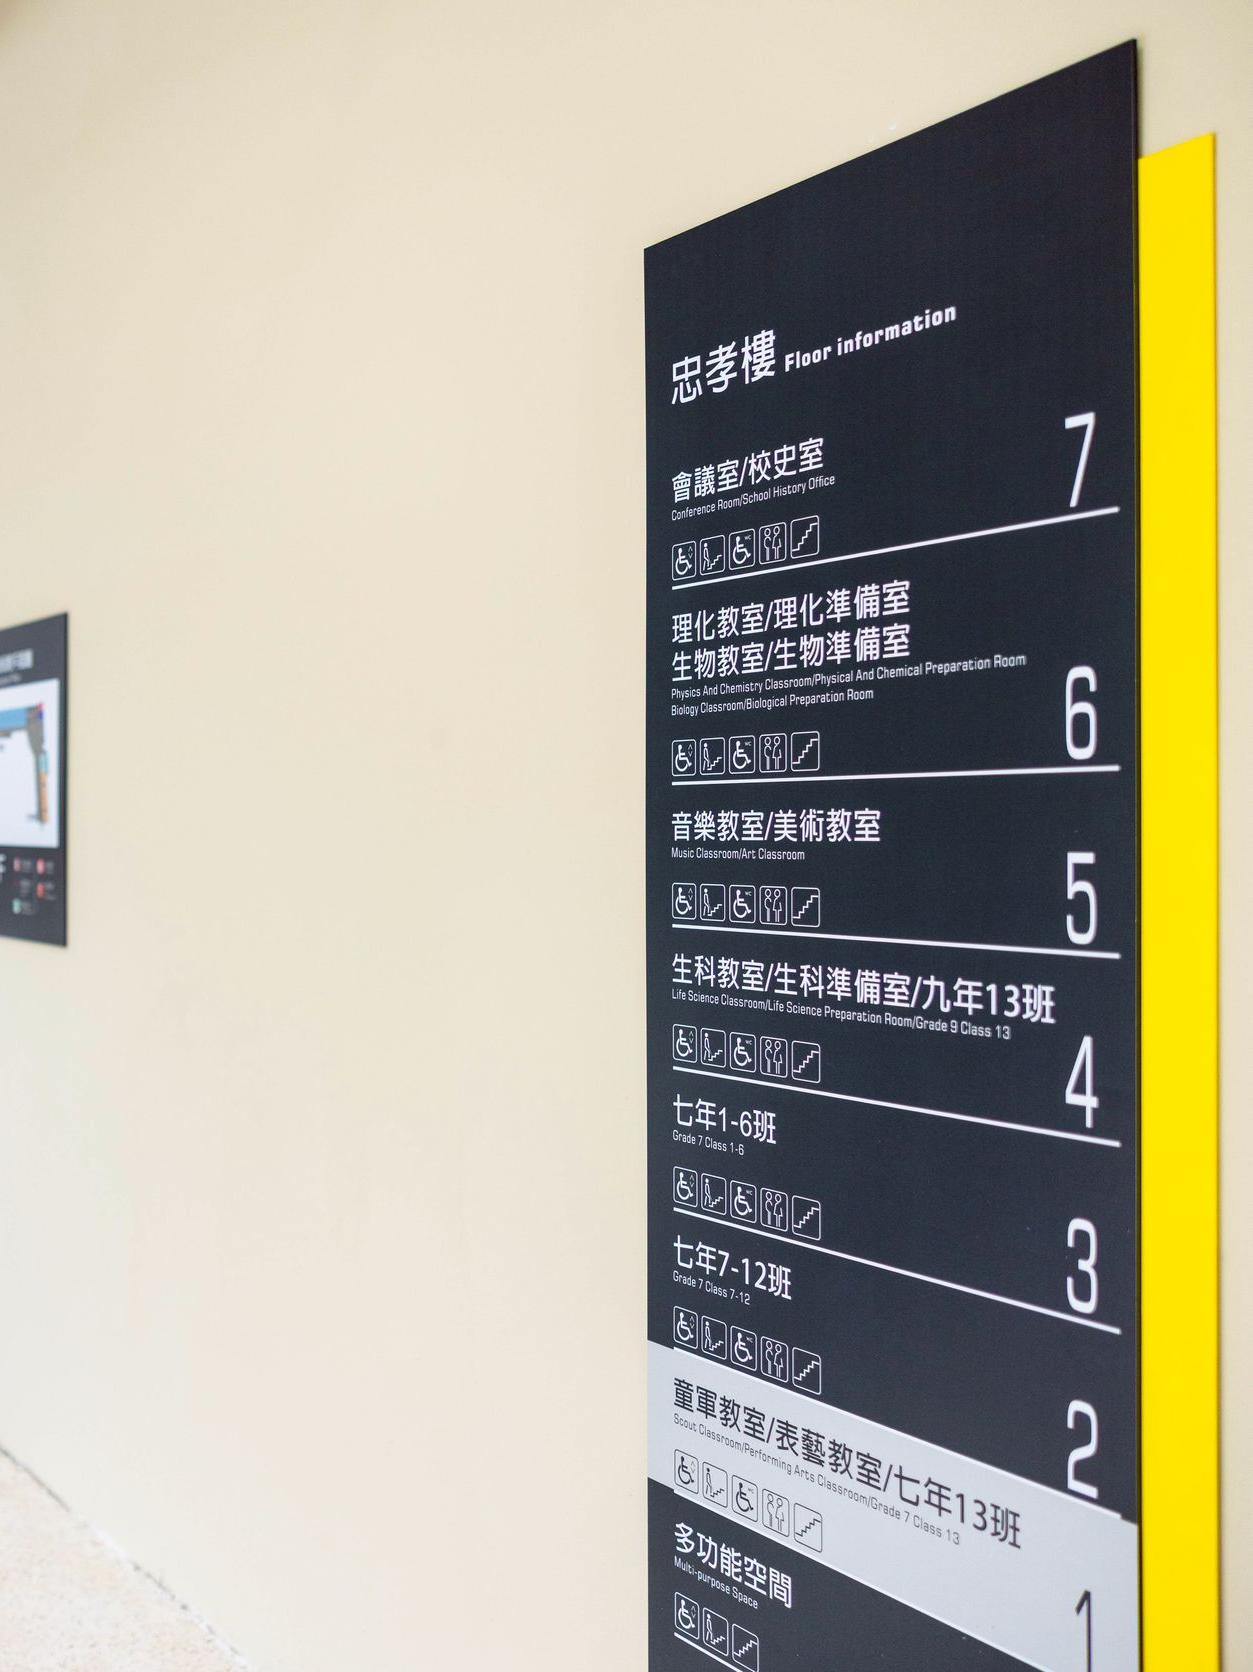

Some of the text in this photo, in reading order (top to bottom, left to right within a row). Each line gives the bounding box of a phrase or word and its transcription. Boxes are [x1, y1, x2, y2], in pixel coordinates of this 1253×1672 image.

[671, 328, 777, 405] 忠孝樓
[785, 305, 957, 373] Floor information
[671, 437, 824, 503] 會議室/校史室
[1064, 412, 1096, 508] 7
[671, 474, 836, 521] Conference Room/School History Office
[671, 579, 911, 644] 理化教室/理化準備室
[671, 623, 911, 682] 生物教室/生物準備室
[671, 654, 1027, 700] Physics And Chemistry Classroom/Physical And Chemical Preparation Room
[671, 688, 874, 717] Biology Classroom/Biological Preparation Room
[1065, 666, 1097, 761] 6
[671, 807, 881, 842] 音樂教室/美術教室
[671, 847, 805, 861] Music Classroom/Art Classroom
[1066, 852, 1097, 945] 5
[672, 953, 1057, 1024] 生科教室/生科準備室/九年13班
[672, 988, 1012, 1040] Life Science Classroom/Life Science Preparation Room/Grade 9 Class 13
[1065, 1036, 1099, 1129] 4
[672, 1129, 745, 1156] Grade 7 Class 1-6
[673, 1093, 777, 1145] 七年1-6班
[672, 1271, 751, 1306] Grade 7 Class 7-12
[673, 1234, 792, 1300] 七年7-12班
[1066, 1218, 1098, 1314] 3
[673, 1377, 1022, 1550] 童軍教室/表藝教室/七年13班
[673, 1413, 960, 1545] Scout Classroom/Performing Arts Classroom/Grade 7 Class 13
[1066, 1399, 1099, 1500] 2
[673, 1555, 759, 1609] Multi-purpose Space
[674, 1522, 792, 1609] 多功能空間
[1075, 1590, 1092, 1672] 1
